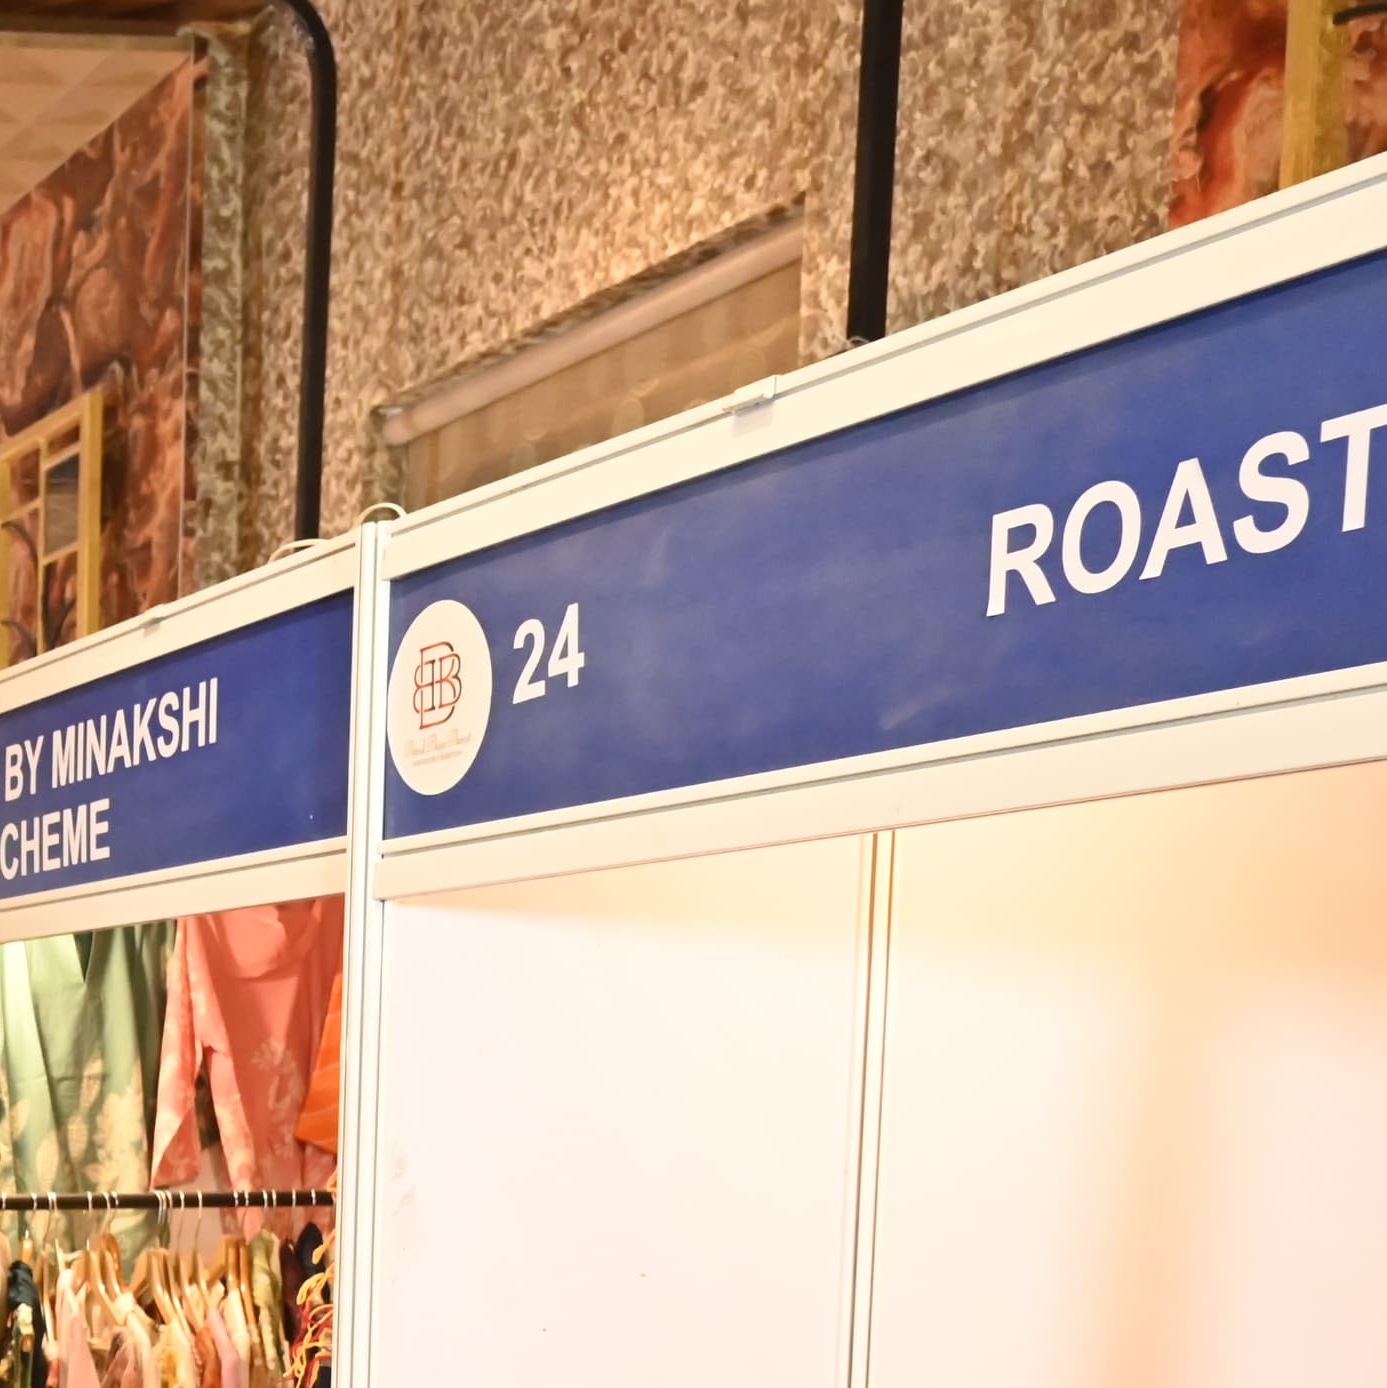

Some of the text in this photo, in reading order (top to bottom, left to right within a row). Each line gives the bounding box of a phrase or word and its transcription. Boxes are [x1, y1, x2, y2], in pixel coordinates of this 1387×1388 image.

[986, 403, 1387, 617] ROAST
[512, 602, 585, 705] 24
[4, 735, 45, 802] BY
[51, 677, 219, 790] MINAKSHI
